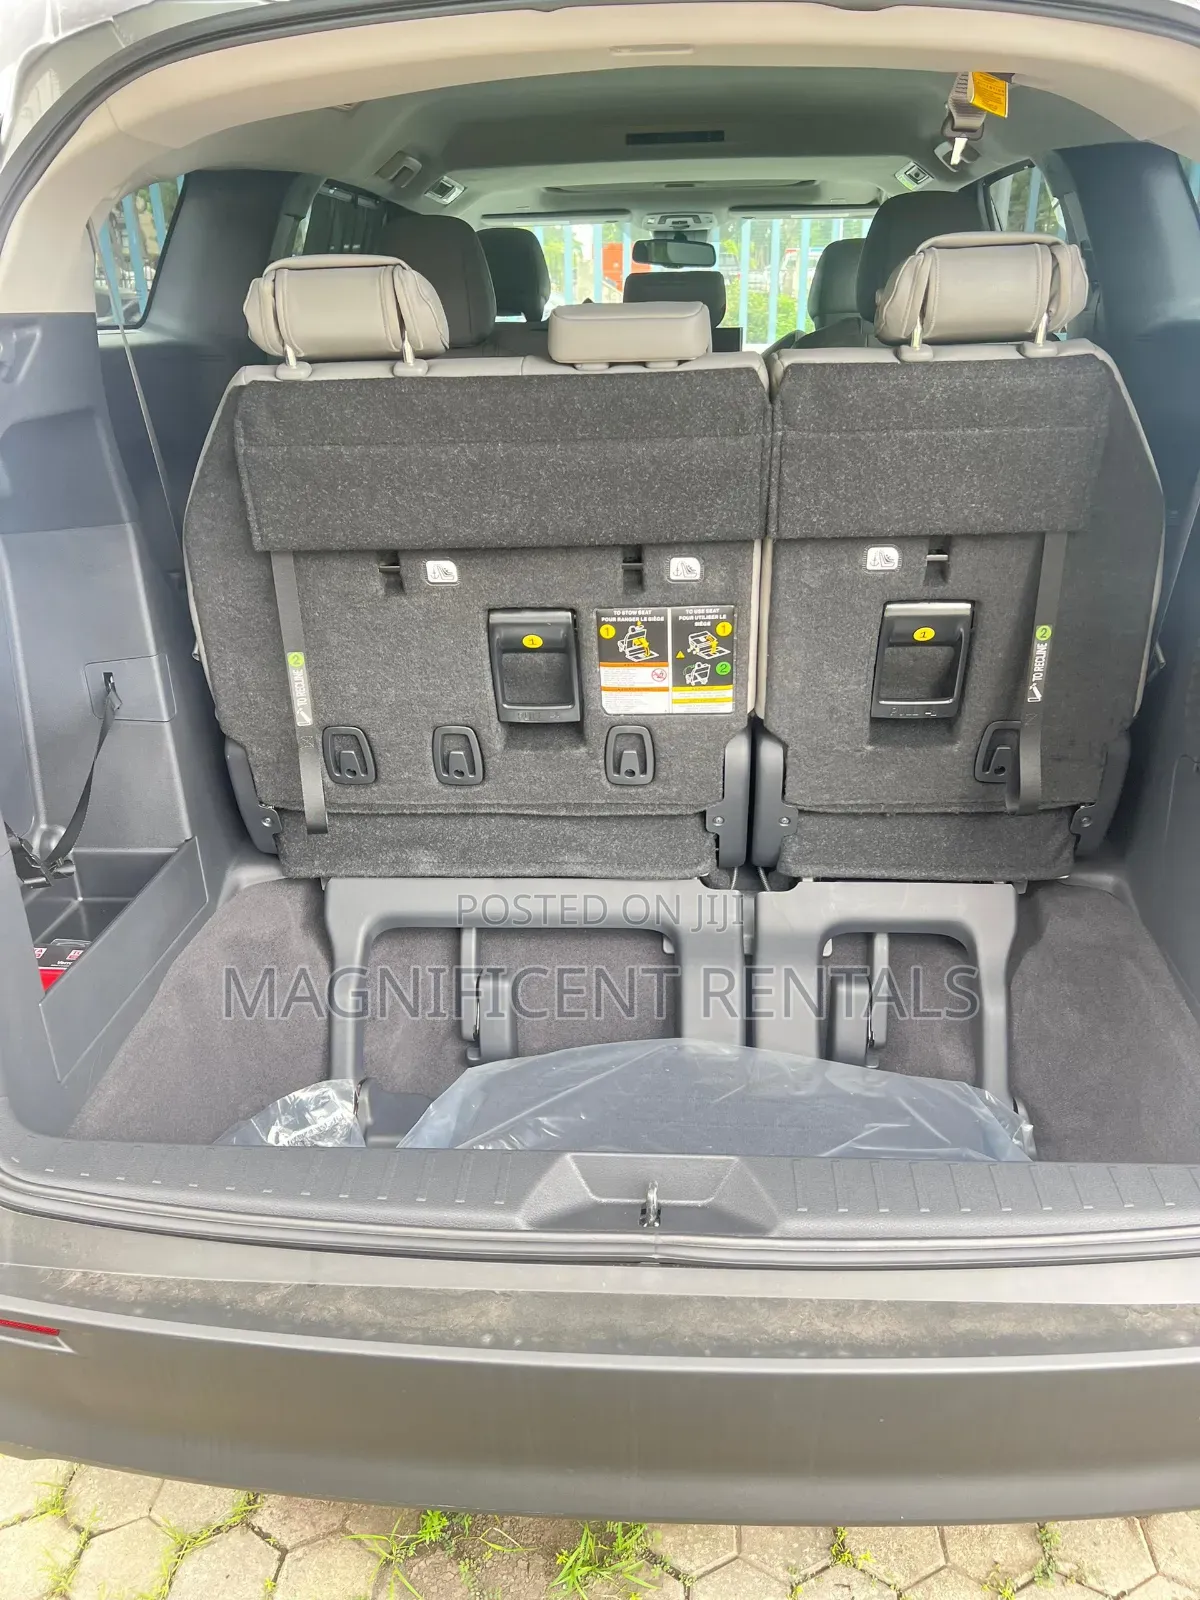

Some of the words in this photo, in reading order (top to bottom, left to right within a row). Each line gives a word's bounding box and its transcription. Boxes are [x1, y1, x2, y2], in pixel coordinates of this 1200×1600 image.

[1034, 642, 1048, 672] RECLINE
[292, 668, 306, 697] RECLINE
[1032, 673, 1043, 682] TO
[296, 697, 307, 707] TO
